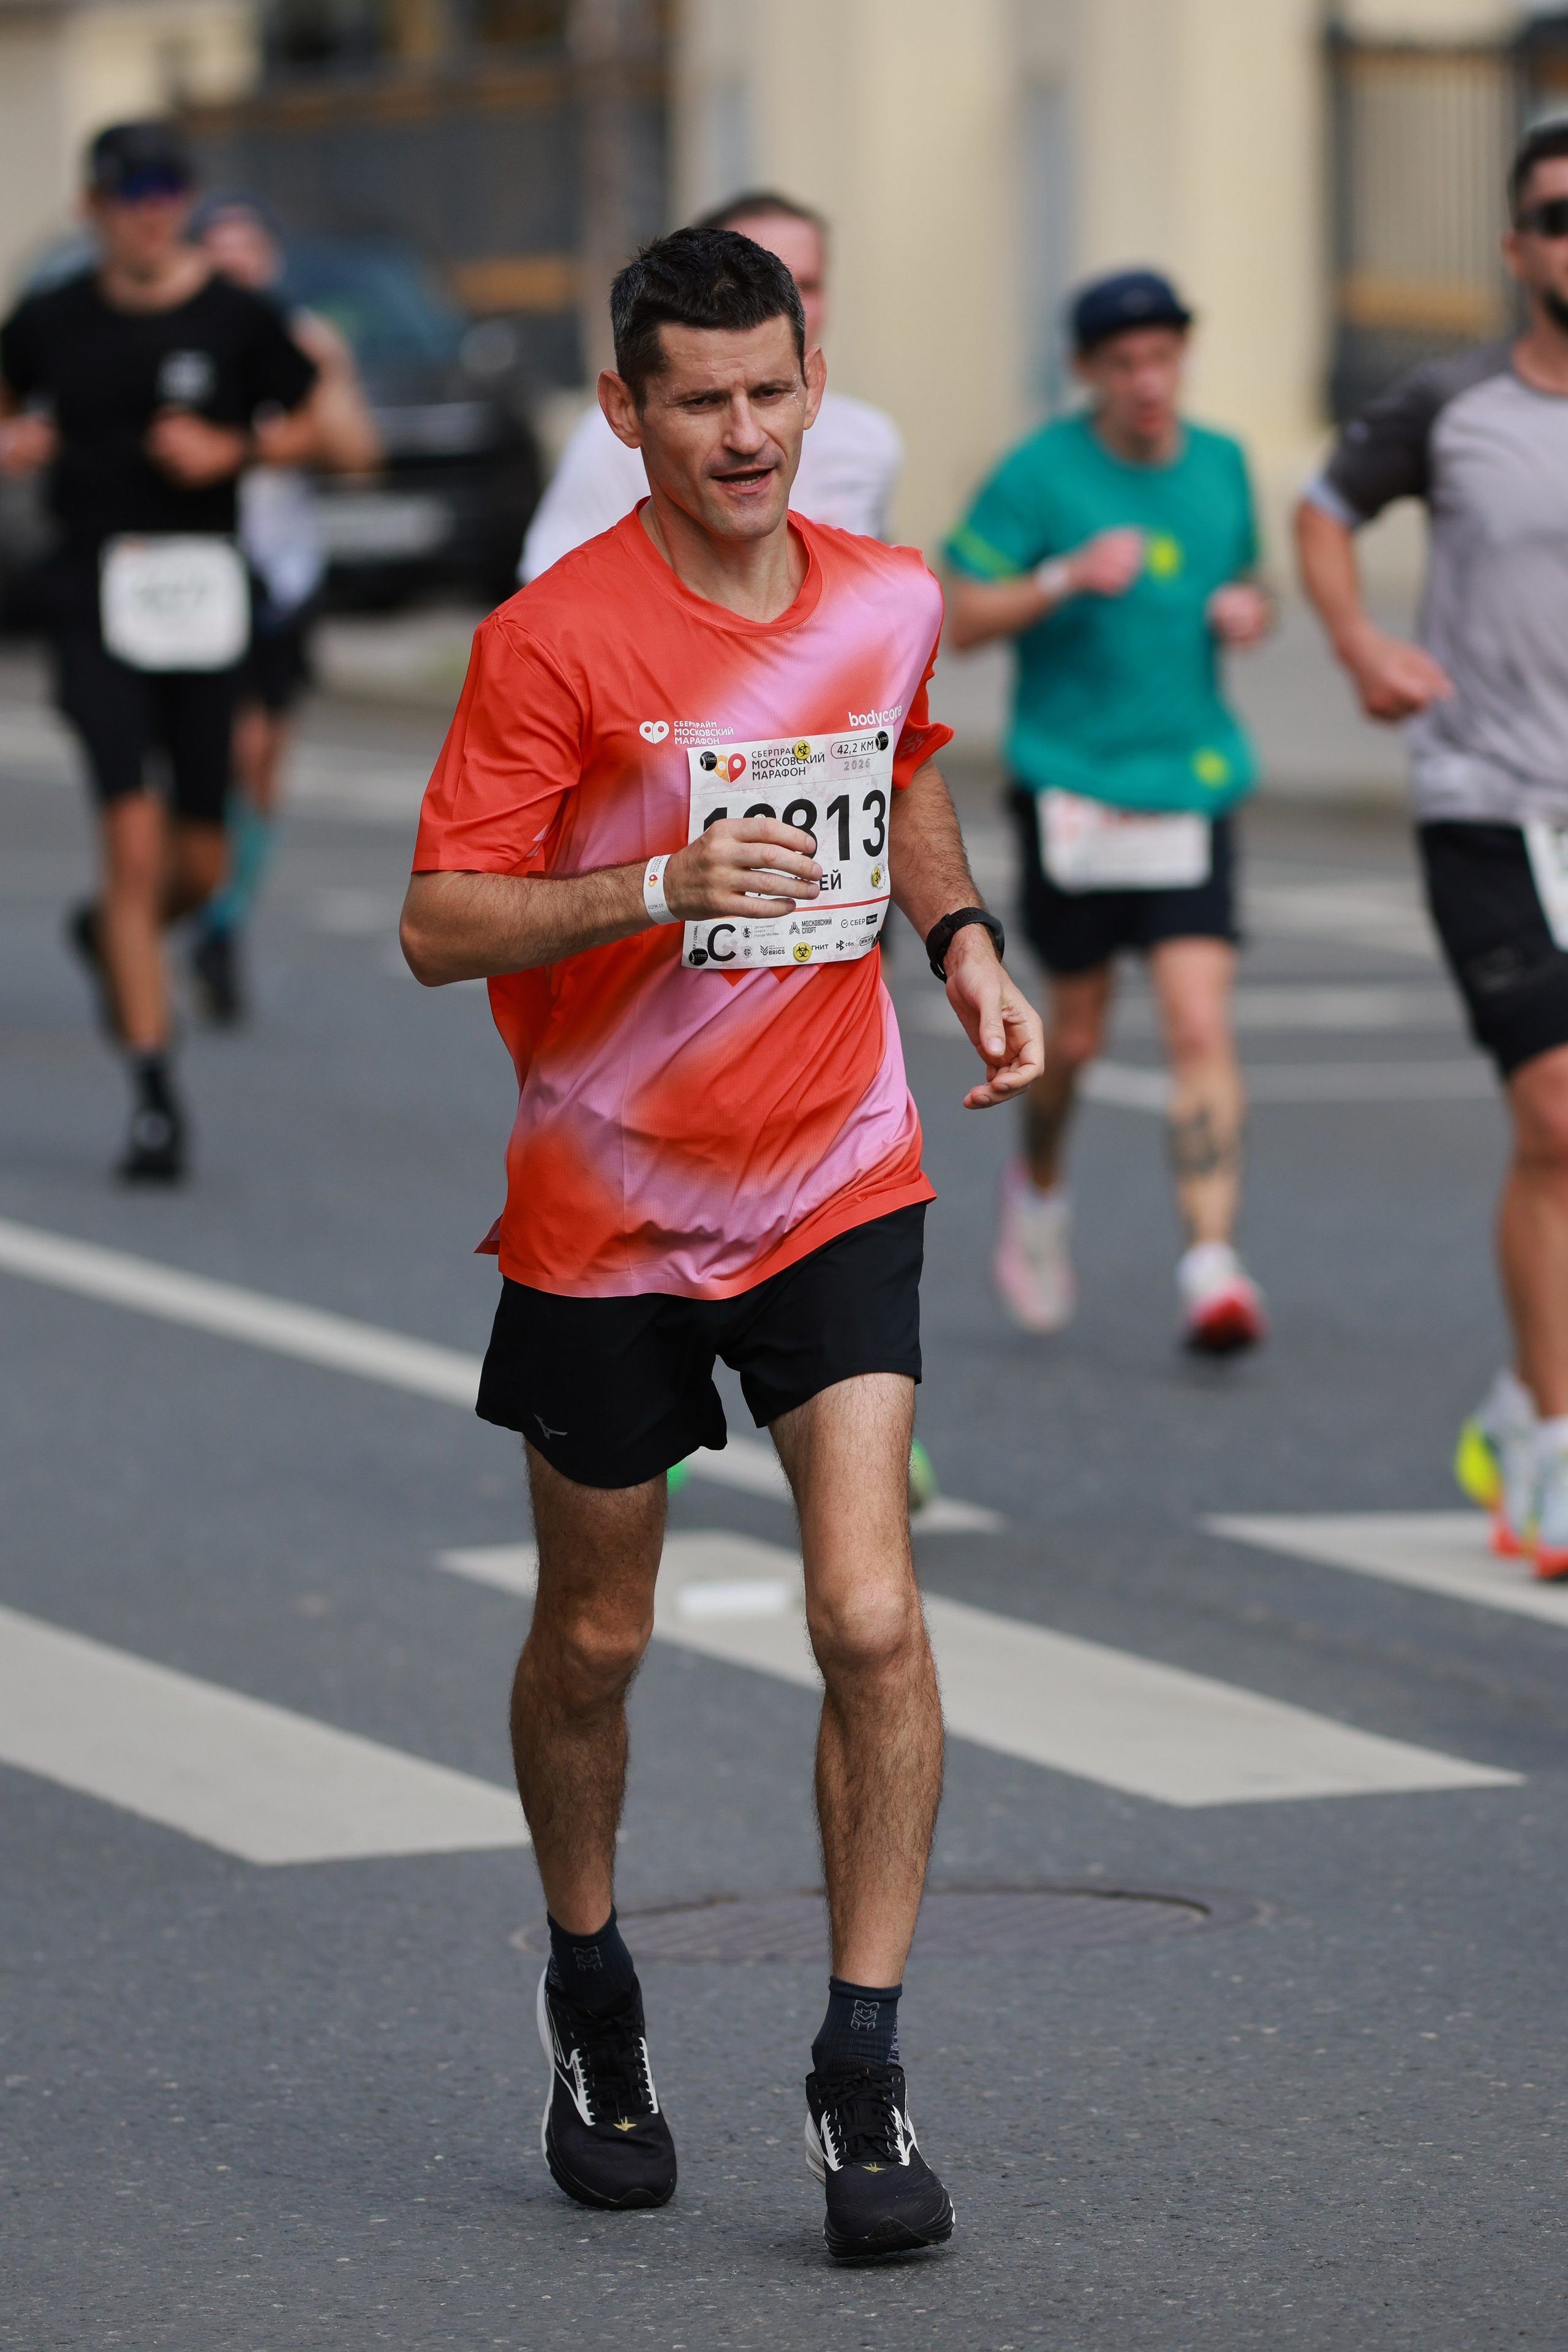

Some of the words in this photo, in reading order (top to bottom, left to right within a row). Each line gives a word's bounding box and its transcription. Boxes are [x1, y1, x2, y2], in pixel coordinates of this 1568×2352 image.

[848, 705, 902, 727] bodycore
[674, 727, 734, 737] МОСКОВСКИЙ
[752, 746, 795, 758] СБЕРПРА
[837, 743, 858, 755] 42,2
[752, 752, 825, 770] МОСКОВСКИЙ
[843, 758, 871, 771] 2026
[752, 767, 806, 781] МАРАФОН
[703, 790, 886, 861] 813
[801, 918, 832, 927] МОСКОВСКИЙ
